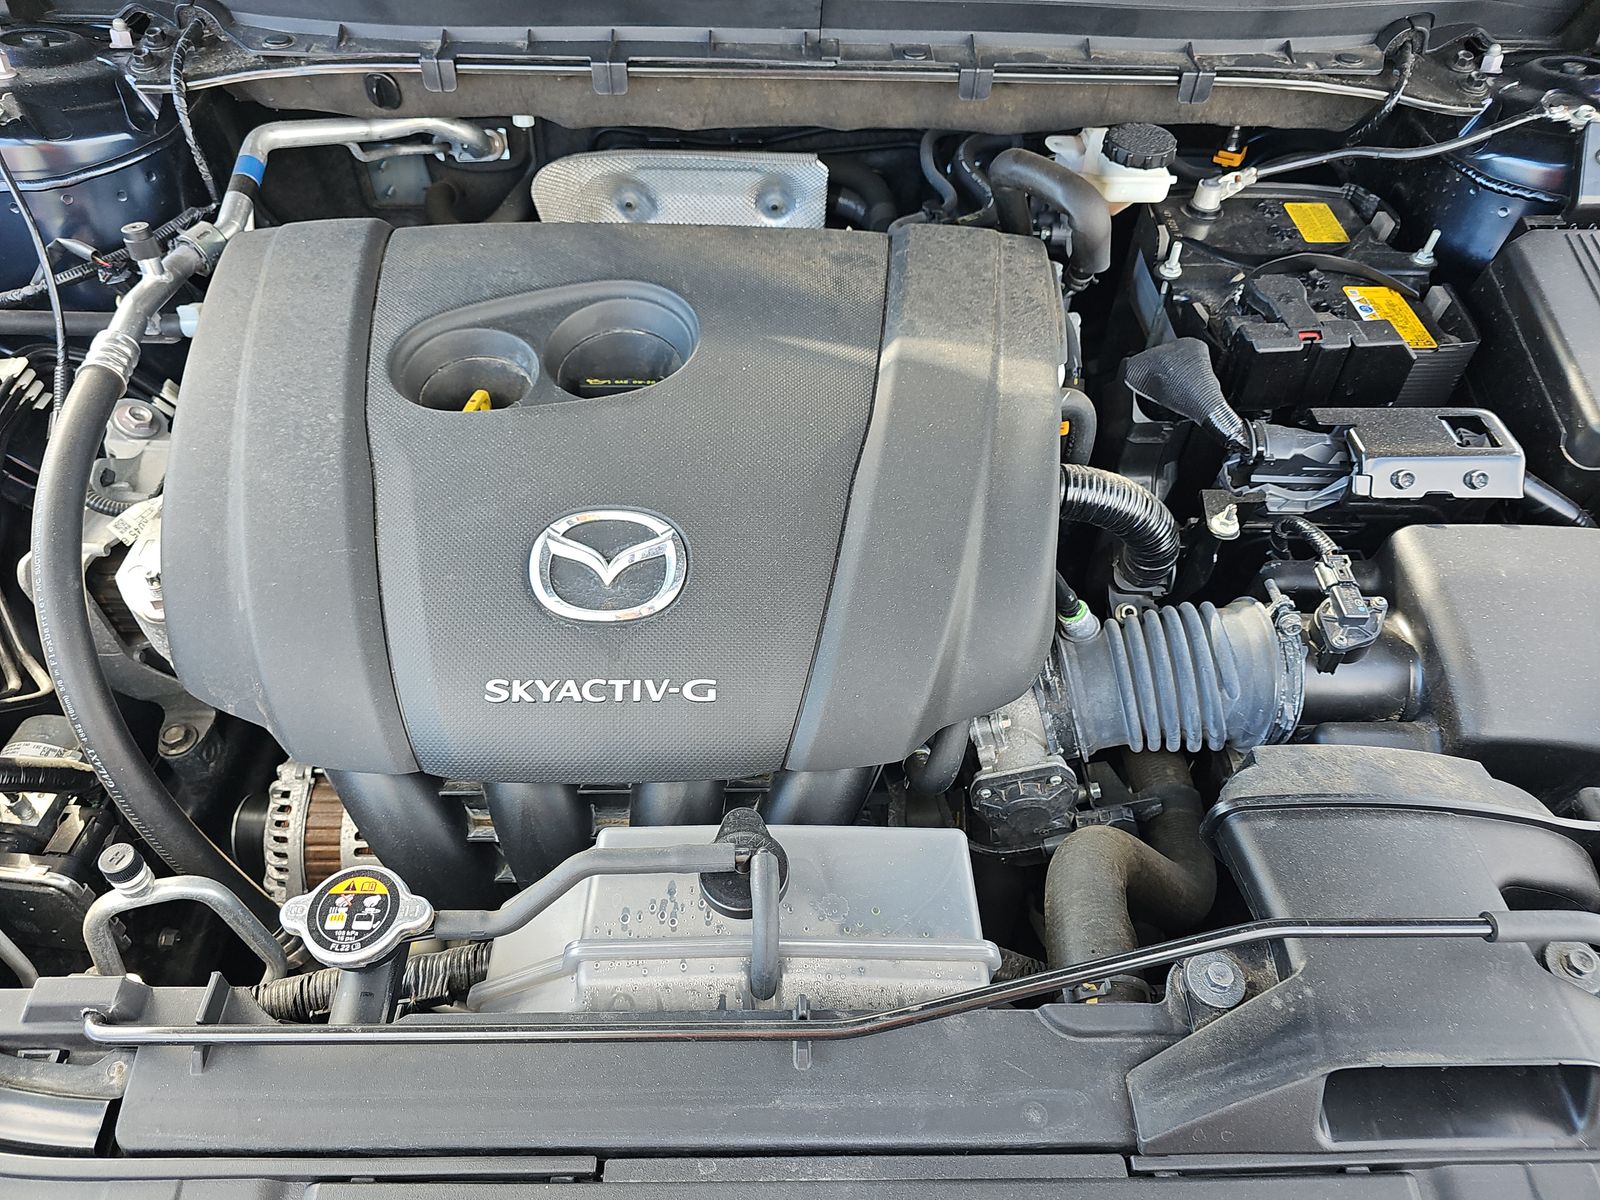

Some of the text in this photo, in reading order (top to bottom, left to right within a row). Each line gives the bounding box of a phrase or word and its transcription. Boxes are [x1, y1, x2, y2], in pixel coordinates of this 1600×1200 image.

[34, 541, 42, 575] SUCTION
[38, 597, 58, 666] Flexbarrier
[484, 678, 717, 703] SKYACTIV-G
[86, 747, 115, 788] GALAXY
[330, 943, 350, 951] FL22
